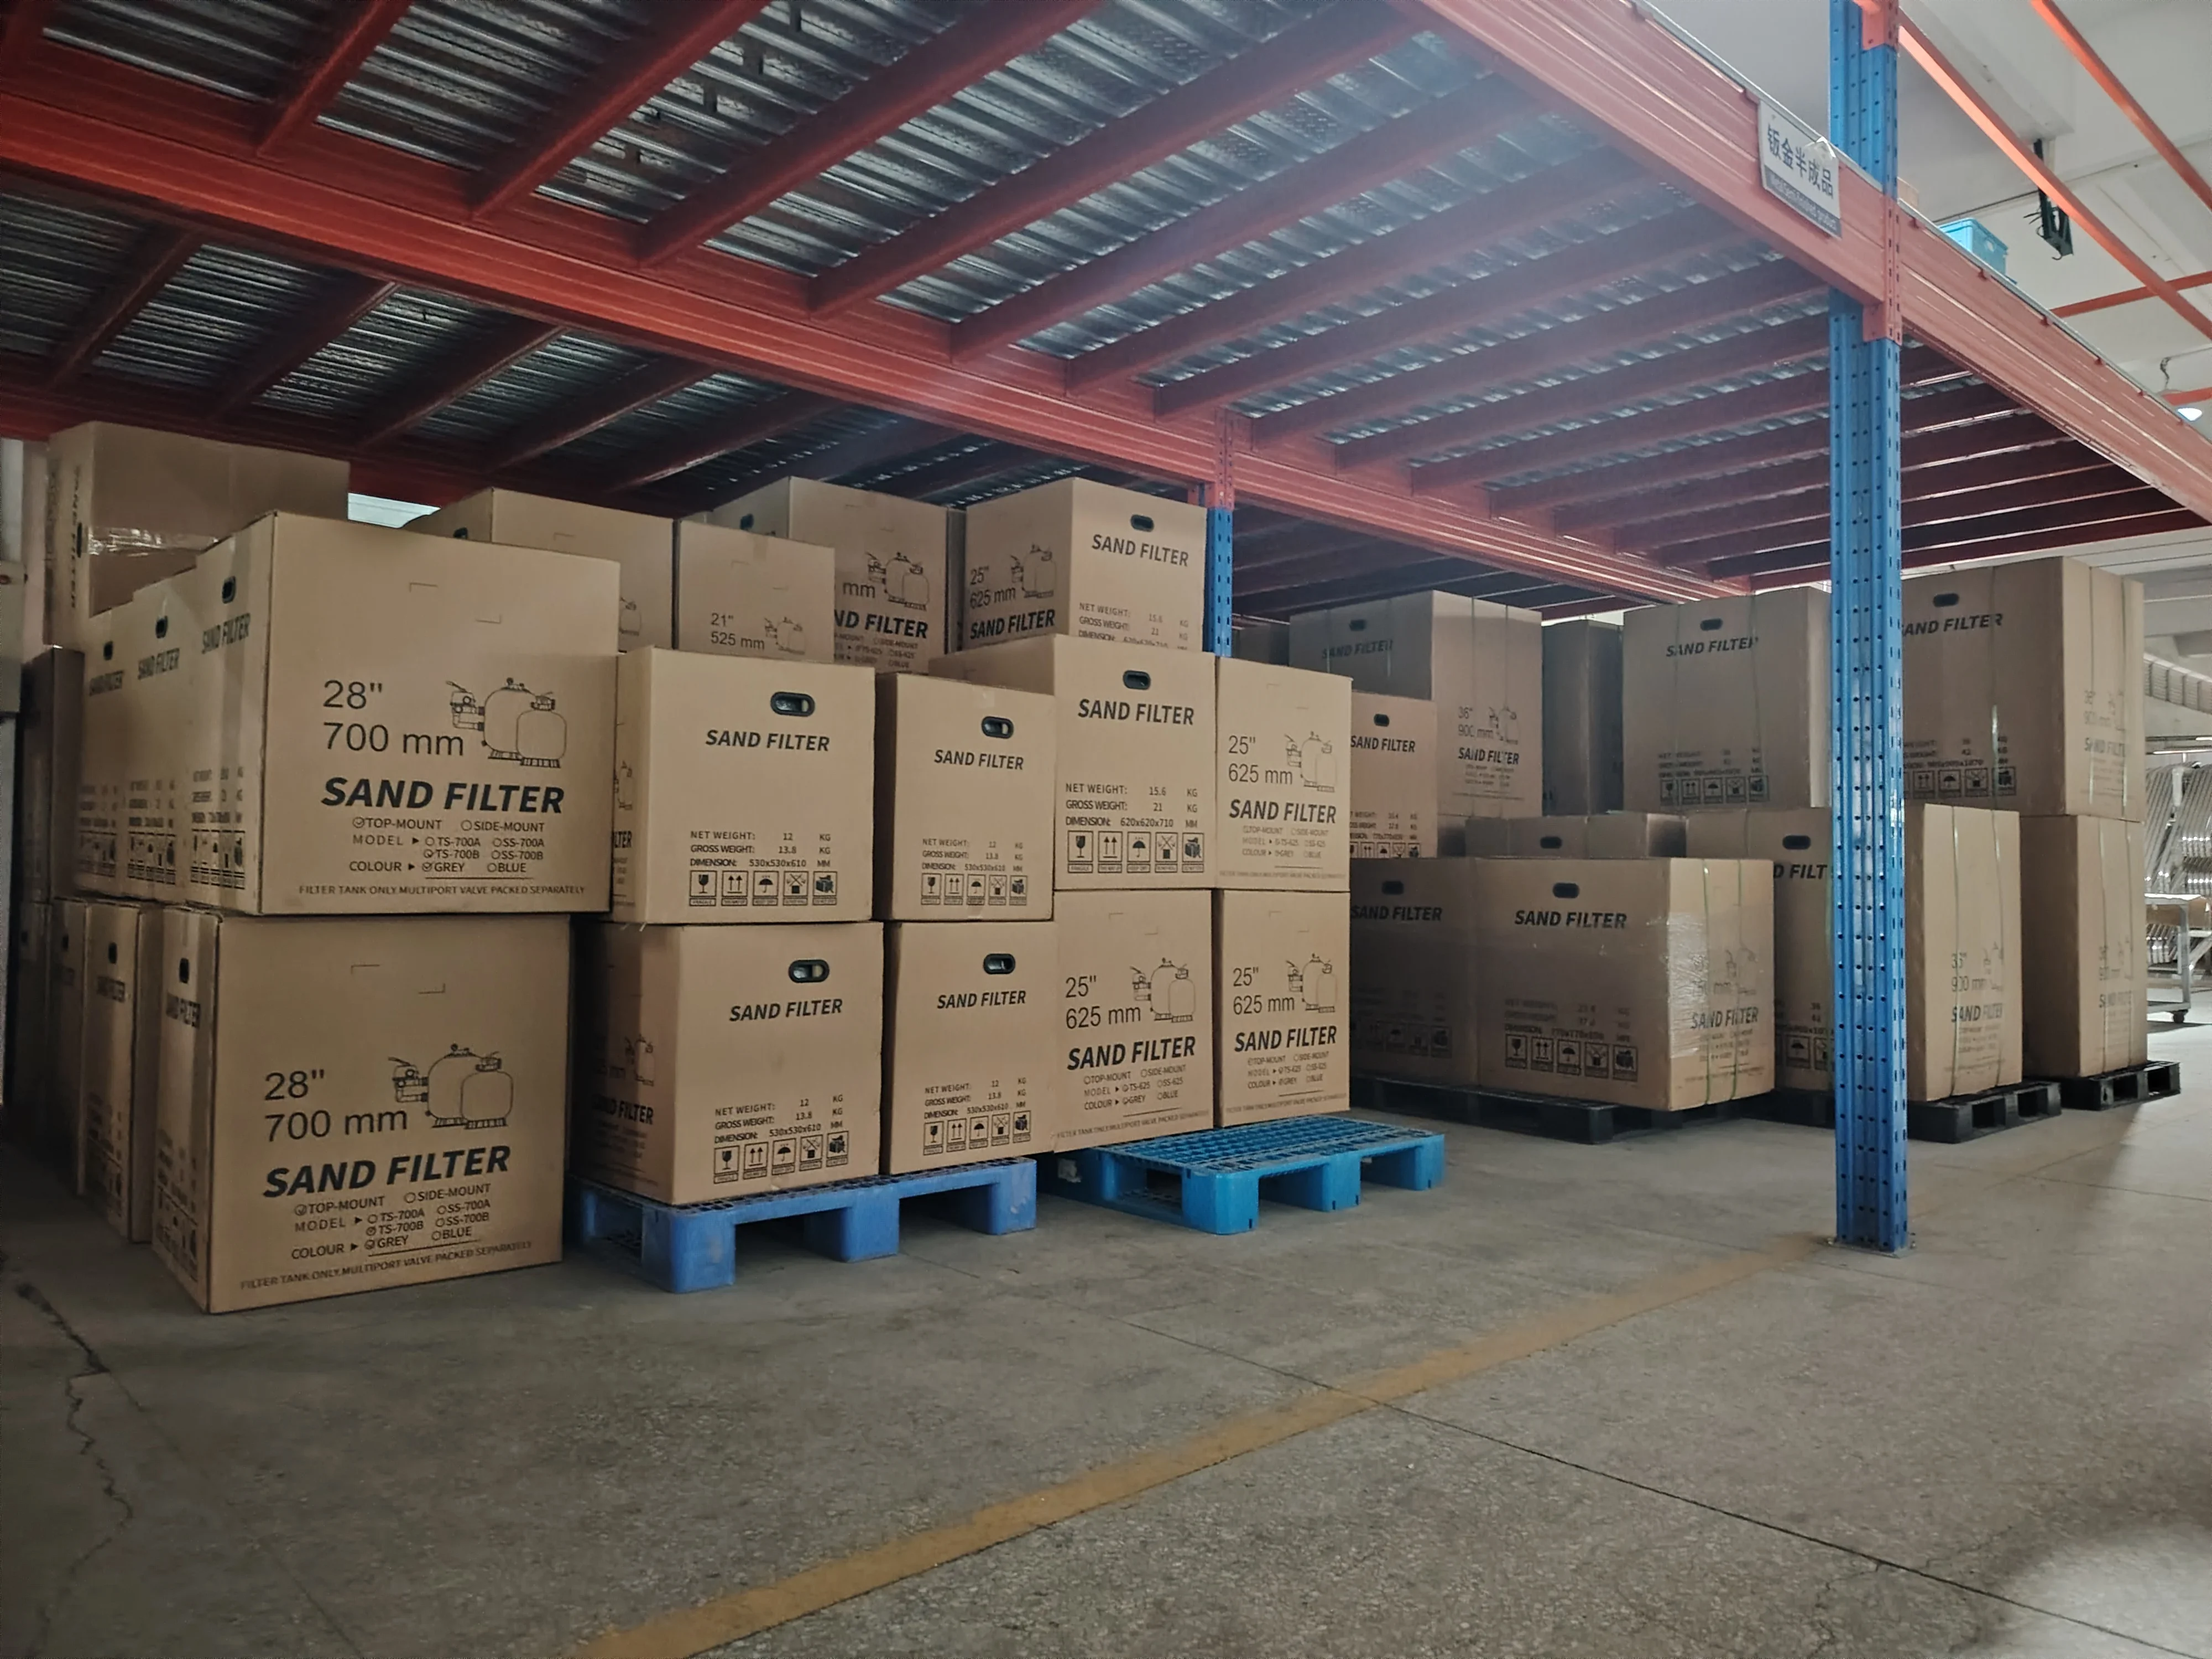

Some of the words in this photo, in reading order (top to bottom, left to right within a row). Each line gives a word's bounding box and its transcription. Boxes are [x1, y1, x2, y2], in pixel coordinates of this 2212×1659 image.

[1092, 534, 1136, 556] SAND
[1140, 542, 1189, 567] FILTER
[969, 589, 991, 609] 625
[994, 586, 1016, 603] mm
[1079, 602, 1094, 612] NET
[865, 613, 928, 639] FILTER
[970, 618, 1005, 640] SAND
[1008, 608, 1056, 634] FILTER
[710, 631, 736, 646] 525
[741, 636, 765, 650] mm
[322, 680, 383, 710] 28"
[1078, 698, 1130, 721] SAND
[1135, 703, 1194, 726] FILTER
[322, 722, 388, 752] 700
[403, 733, 463, 756] mm
[706, 729, 761, 748] SAND
[767, 733, 830, 752] FILTER
[1228, 735, 1256, 755] 25"
[1350, 735, 1379, 750] SAND
[1381, 738, 1416, 753] FILTER
[934, 749, 974, 766] SAND
[978, 753, 1024, 770] FILTER
[1458, 747, 1485, 761] SAND
[1228, 763, 1259, 783] 625
[1265, 769, 1293, 785] mm
[321, 776, 434, 808] SAND
[444, 782, 565, 813] FILTER
[1066, 783, 1084, 793] NET
[1087, 784, 1128, 795] WEIGHT:
[1149, 786, 1166, 796] 15.6
[1186, 789, 1197, 797] KG
[1066, 800, 1093, 810] GROSS
[1094, 801, 1128, 811] WEIGHT:
[1153, 803, 1162, 812] 21
[1187, 805, 1197, 813] KG
[1229, 799, 1279, 820] SAND
[1284, 802, 1337, 824] FILTER
[365, 817, 442, 830] TOP-MOUNT
[473, 821, 544, 832] SIDE-MOUNT
[1120, 818, 1173, 828] 620x620x710
[1186, 820, 1197, 828] MM
[353, 835, 403, 846] MODEL
[437, 837, 481, 848] TS-700A
[502, 838, 544, 848] SS-700A
[691, 831, 709, 839] NET
[435, 849, 479, 860] TS-700B
[499, 851, 543, 860] SS-700B
[349, 861, 402, 872] COLOUR
[434, 862, 465, 873] GREY
[498, 863, 526, 873] BLUE
[1790, 864, 1832, 879] FILT
[299, 885, 335, 895] FILTER
[338, 886, 367, 895] TANK
[460, 886, 488, 895] VALVE
[491, 886, 528, 895] PACKED
[1350, 905, 1389, 920] SAND
[1392, 907, 1442, 921] FILTER
[1514, 910, 1561, 926] SAND
[1566, 912, 1627, 929] FILTER
[1065, 975, 1097, 998] 25"
[1233, 967, 1259, 987] 25"
[729, 1003, 780, 1021] SAND
[786, 998, 843, 1018] FILTER
[937, 993, 977, 1009] SAND
[981, 990, 1026, 1006] FILTER
[1233, 995, 1262, 1015] 625
[1268, 997, 1295, 1013] mm
[1066, 1006, 1101, 1029] 625
[1108, 1006, 1141, 1025] mm
[1234, 1030, 1282, 1052] SAND
[1286, 1025, 1337, 1048] FILTER
[1067, 1043, 1126, 1071] SAND
[1131, 1035, 1196, 1063] FILTER
[264, 1070, 325, 1101] 28"
[1084, 1087, 1111, 1097] MODEL
[715, 1107, 733, 1116] NET
[736, 1103, 775, 1114] WEIGHT:
[833, 1094, 843, 1103] KG
[925, 1098, 946, 1107] GROSS
[1084, 1099, 1112, 1110] COLOUR
[264, 1110, 331, 1141] 700
[345, 1110, 407, 1135] mm
[715, 1120, 742, 1130] GROSS
[743, 1117, 774, 1127] WEIGHT:
[796, 1112, 812, 1120] 13.8
[769, 1124, 821, 1137] 530x530x610
[263, 1160, 376, 1198] SAND
[387, 1145, 510, 1185] FILTER
[308, 1196, 385, 1214] TOP-MOUNT
[417, 1183, 491, 1202] SIDE-MOUNT
[295, 1217, 346, 1233] MODEL
[379, 1209, 425, 1223] TS-700A
[447, 1200, 491, 1213] SS-700A
[378, 1221, 424, 1235] TS-700B
[446, 1212, 489, 1225] SS-700B
[291, 1244, 345, 1259] COLOUR
[377, 1235, 409, 1249] GREY
[442, 1227, 472, 1240] BLUE
[435, 1250, 473, 1262] PACKED
